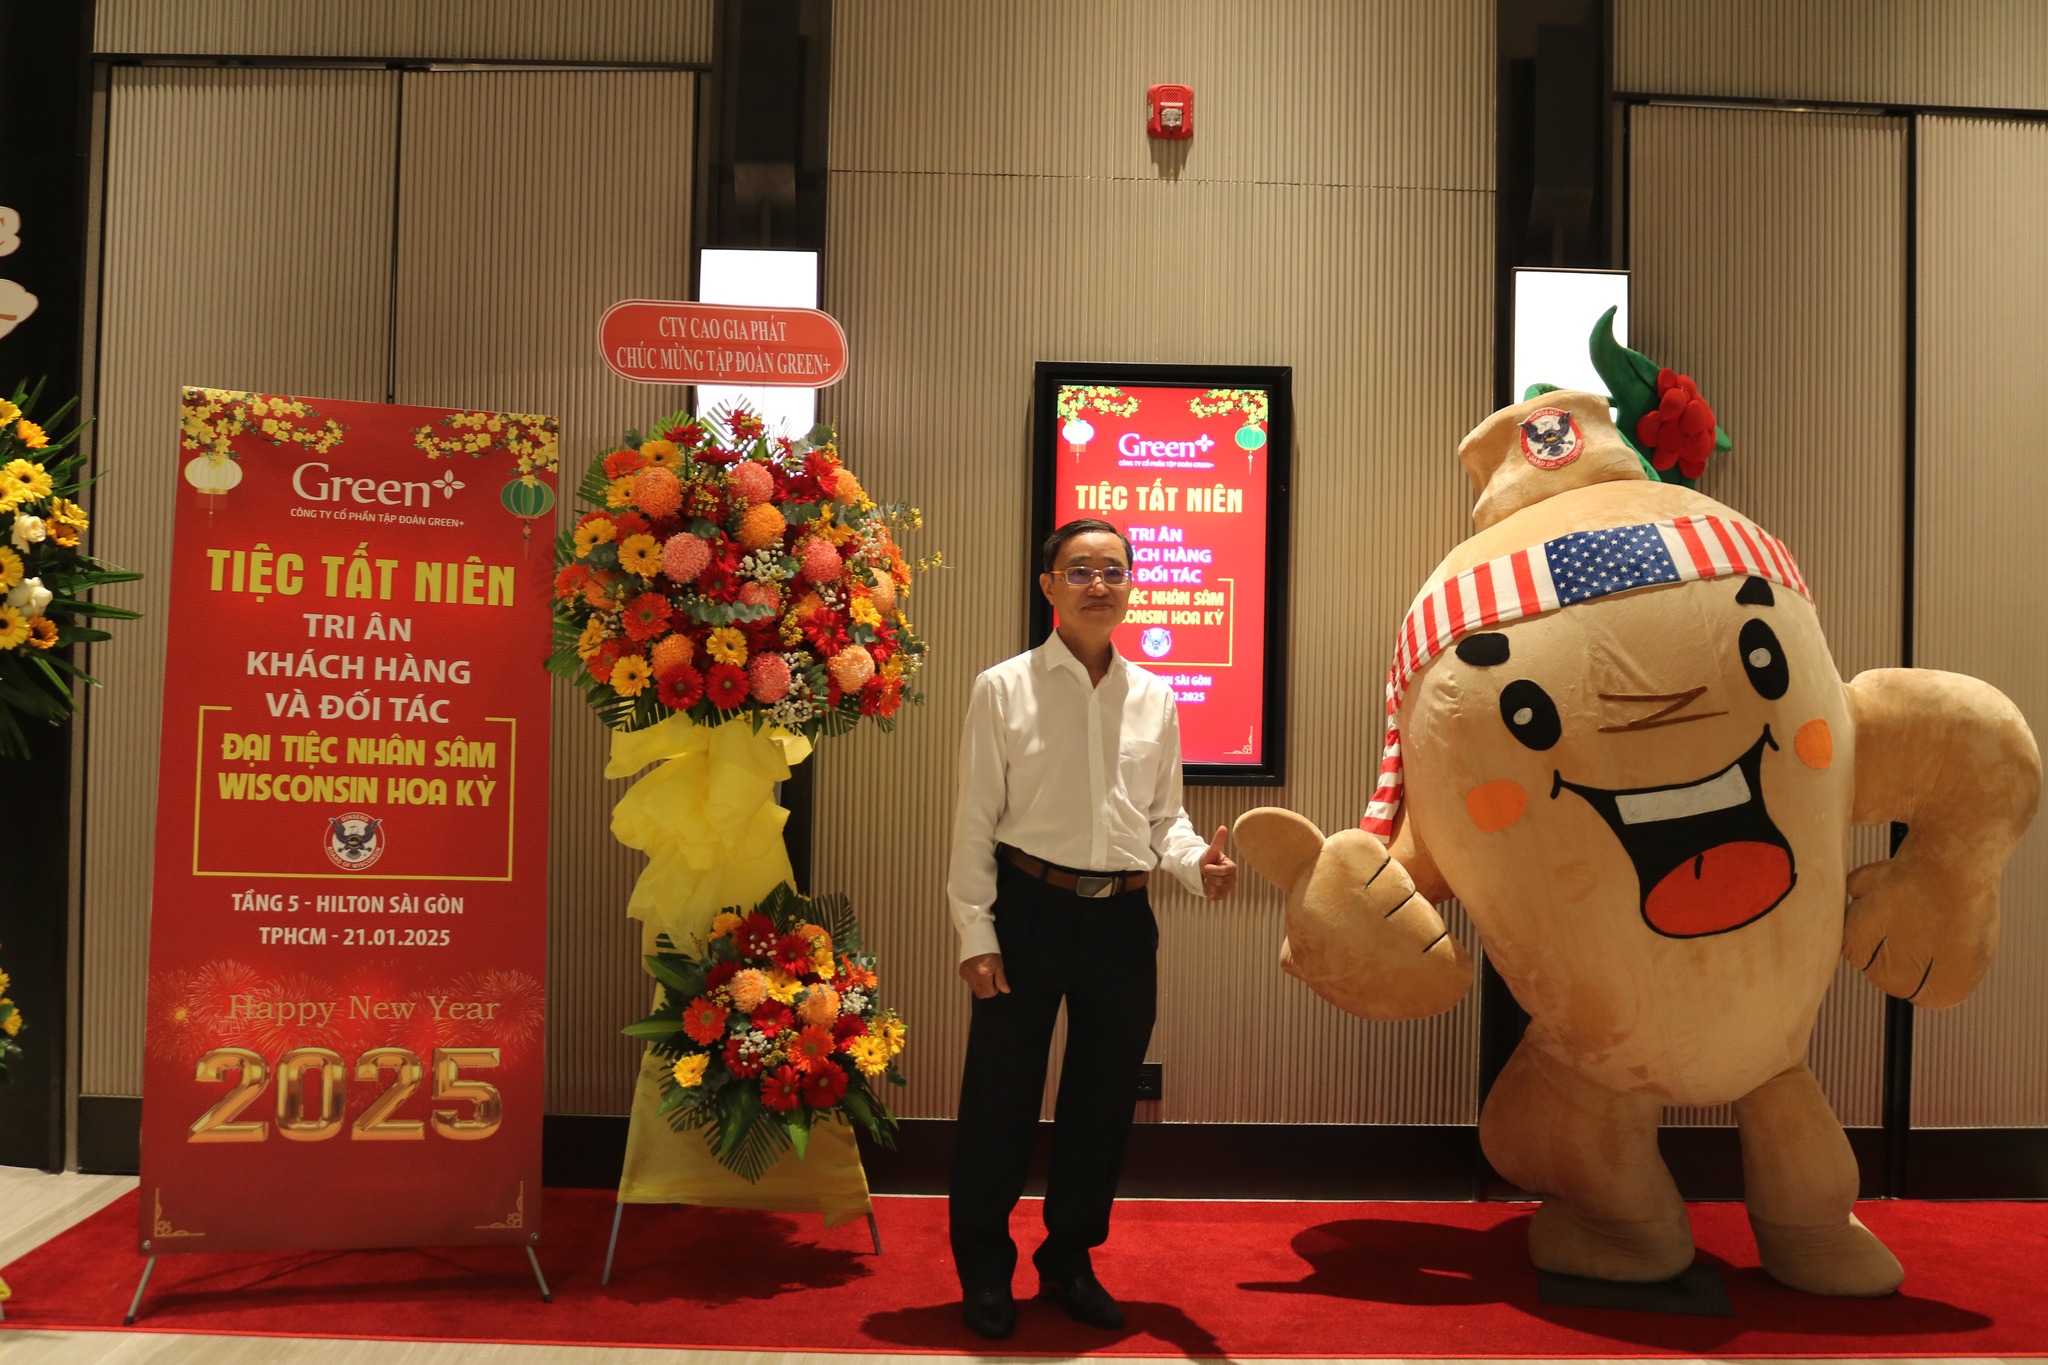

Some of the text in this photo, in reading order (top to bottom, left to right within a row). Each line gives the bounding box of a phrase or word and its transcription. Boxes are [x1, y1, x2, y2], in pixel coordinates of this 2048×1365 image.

[659, 315, 787, 342] CTY CAO GIA PHÁT
[616, 341, 831, 377] CHÚC MỪNG TẬP ĐOÀN GREEN+
[1075, 478, 1242, 515] TIỆC TẤT NIÊN
[290, 507, 317, 519] CÔNG
[319, 510, 332, 519] TY
[334, 507, 347, 520] CỔ
[378, 512, 397, 525] TẬP
[399, 514, 426, 526] ĐOÀN
[428, 517, 465, 528] GREEN+
[1128, 526, 1183, 542] TRI ÂN
[1163, 546, 1212, 563] HÀNG
[206, 542, 515, 607] TIỆC TẤT NIÊN
[1137, 565, 1202, 583] ĐỐI TÁC
[1151, 588, 1191, 606] NHÂN
[1193, 588, 1225, 607] SÂM
[303, 612, 412, 642] TRI ÂN
[1171, 610, 1201, 625] HOA
[246, 649, 471, 685] KHÁCH HÀNG
[265, 689, 451, 724] VÀ ĐỐI TÁC
[221, 730, 496, 770] ĐẠI TIỆC NHÂN SÂM
[218, 772, 497, 807] WISCONSIN HOA KỲ
[231, 889, 283, 912] TẦNG
[287, 895, 299, 912] 5
[316, 895, 384, 913] HILTON
[389, 893, 419, 914] SÀI
[424, 893, 464, 914] GÒN
[259, 927, 327, 945] TPHCM
[343, 928, 450, 946] 21.01.2025
[226, 994, 501, 1027] Happy New Year
[187, 1047, 502, 1143] 2025
